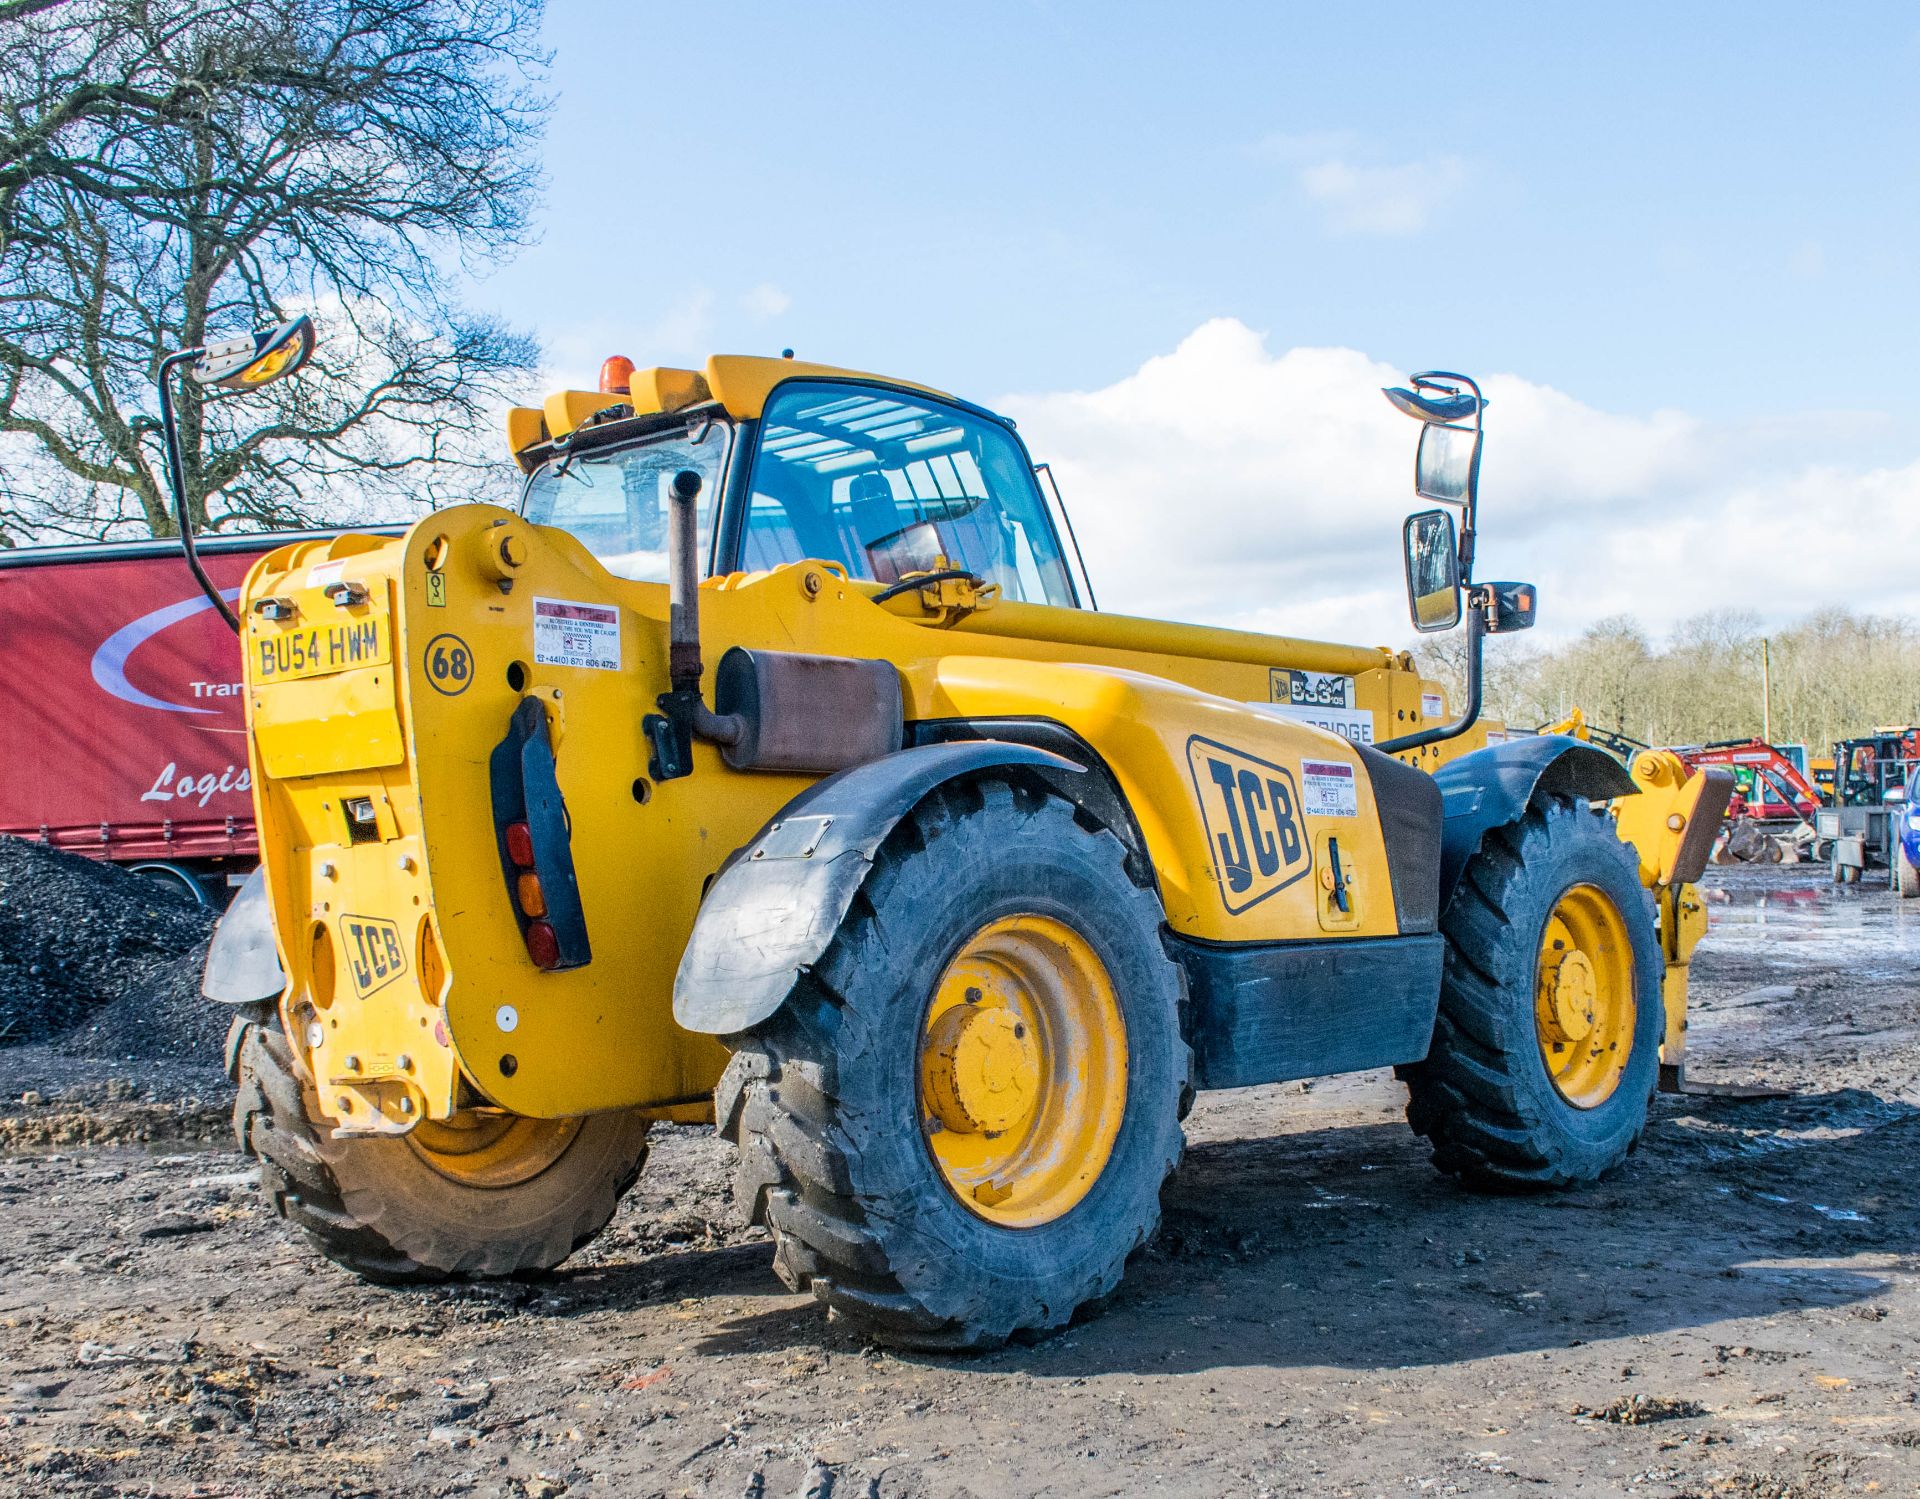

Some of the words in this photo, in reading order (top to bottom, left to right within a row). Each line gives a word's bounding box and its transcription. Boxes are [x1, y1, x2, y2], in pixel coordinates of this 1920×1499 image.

[260, 631, 320, 676] BU54
[328, 620, 378, 665] HWM
[432, 647, 467, 681] 68
[570, 657, 584, 666] 870
[585, 658, 600, 668] 606
[601, 660, 618, 669] 4725
[1207, 757, 1302, 893] JCB
[349, 923, 402, 989] JCB
